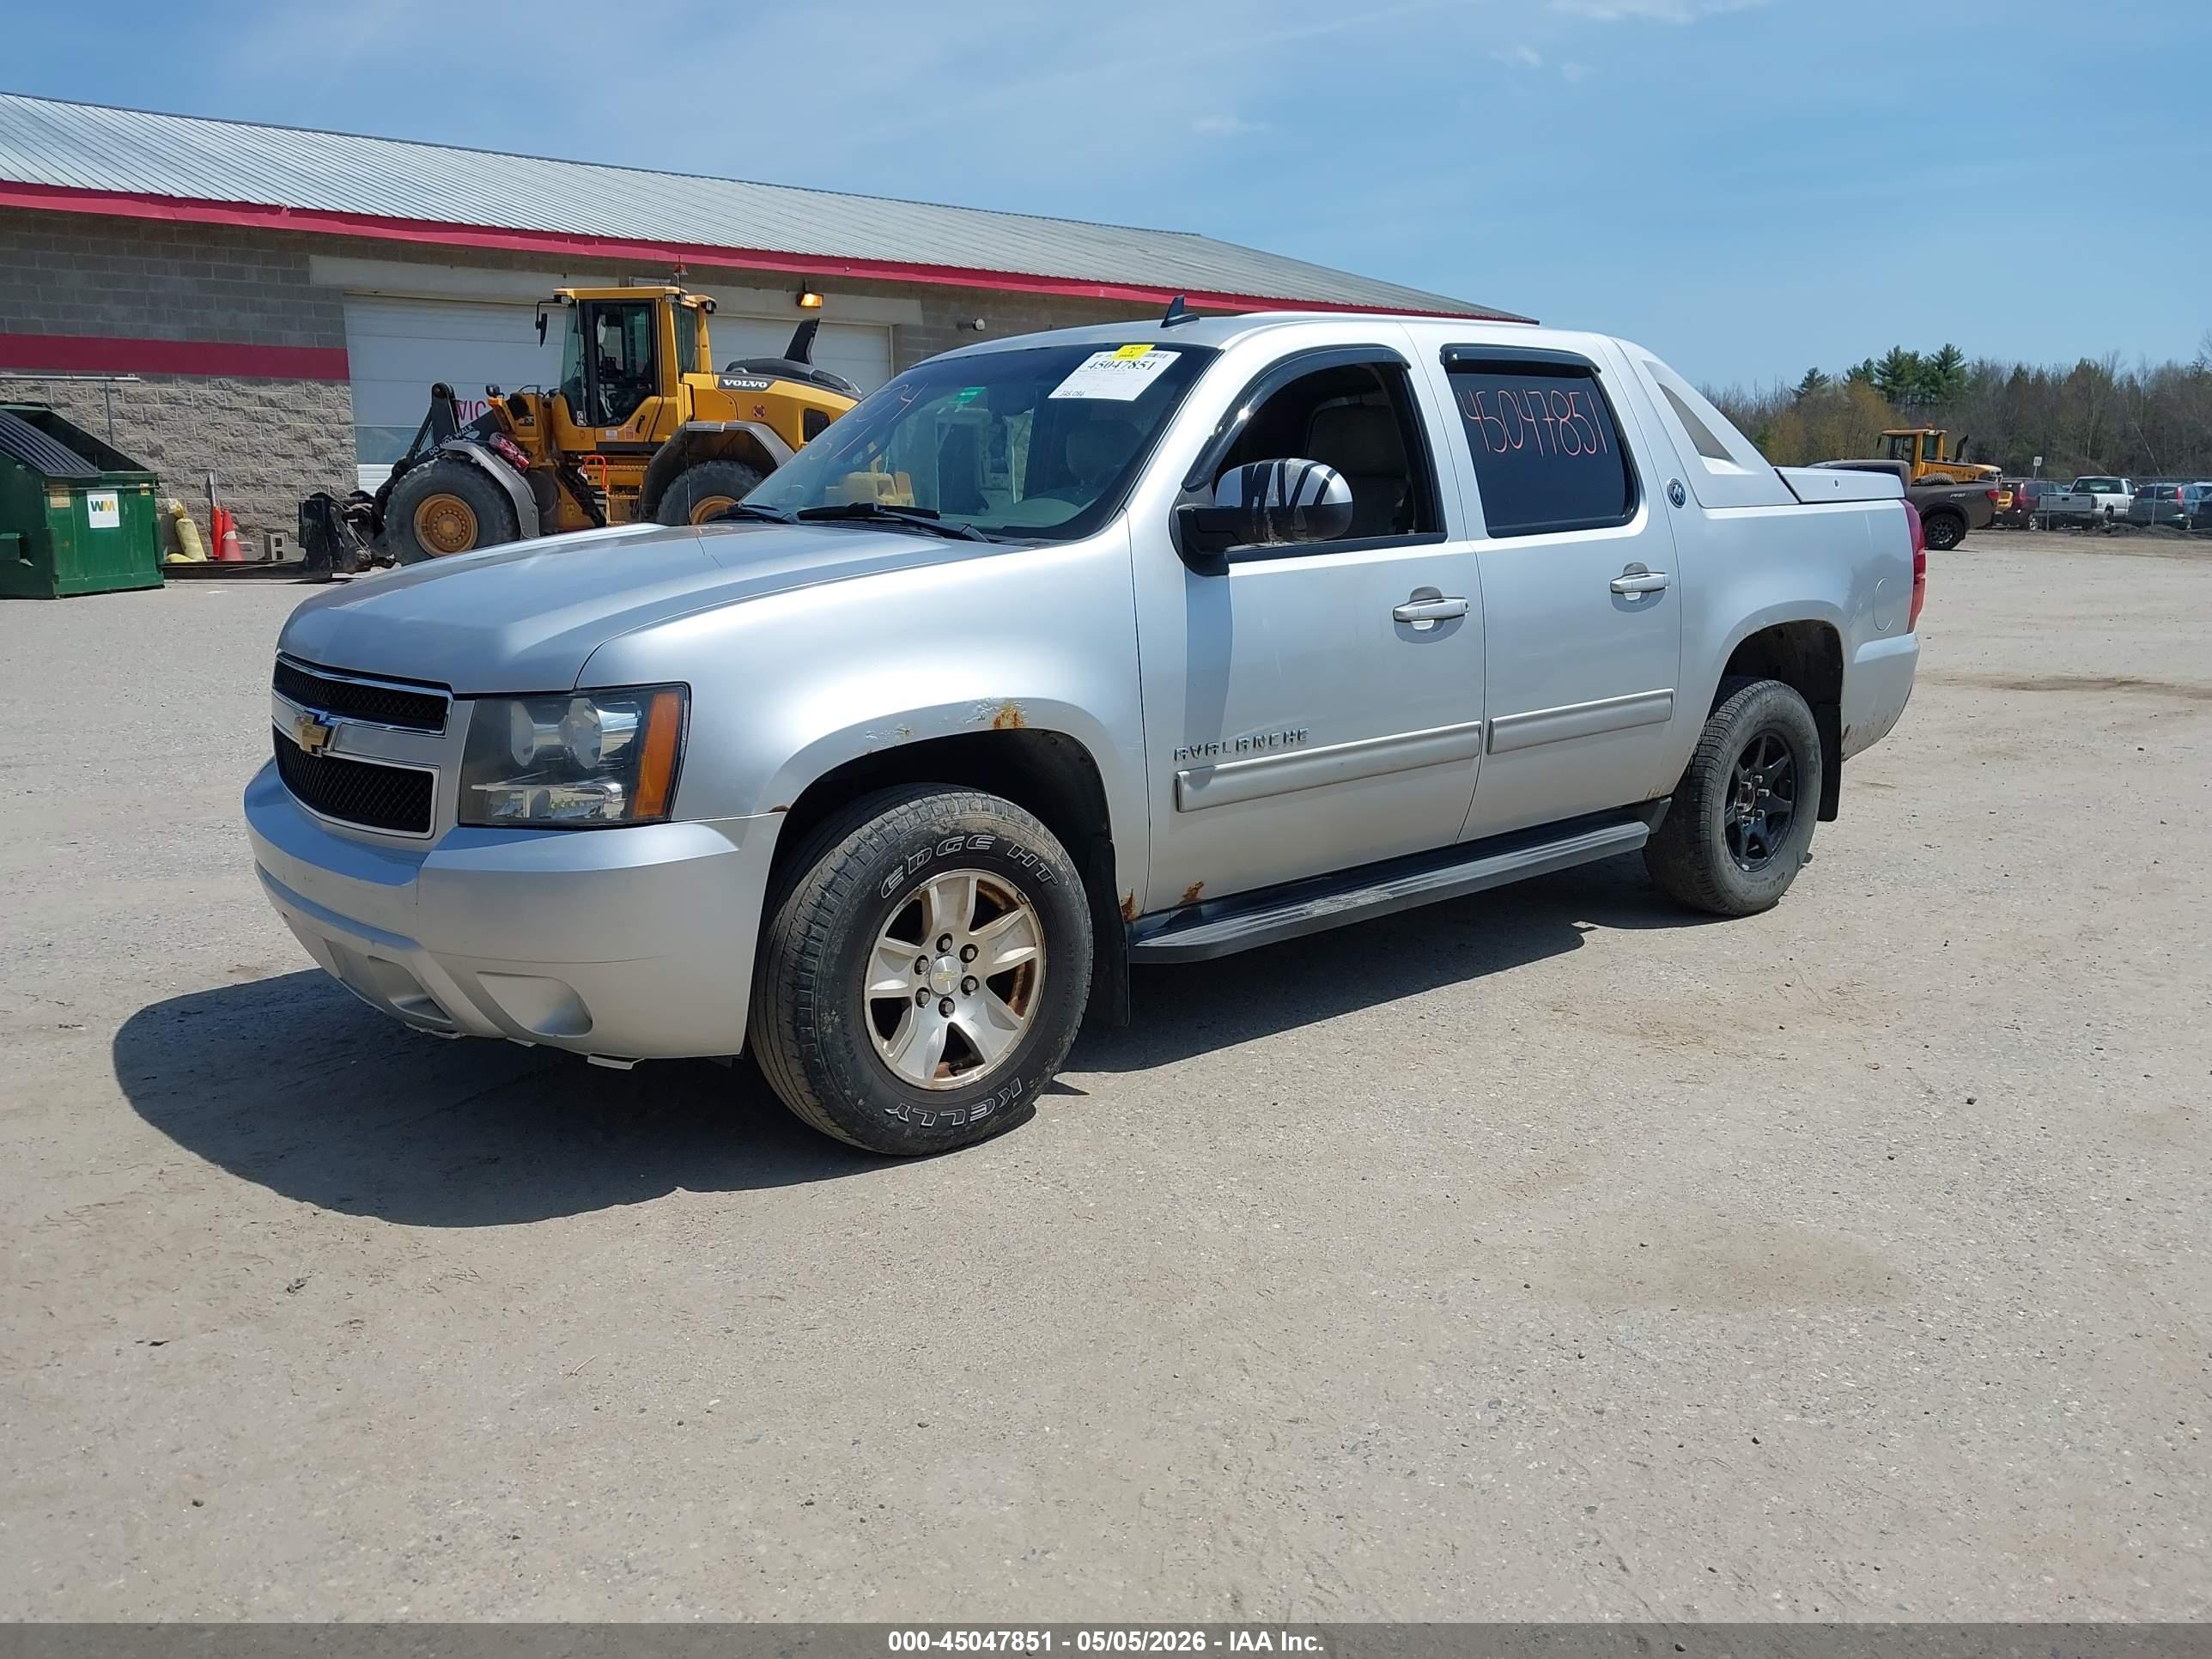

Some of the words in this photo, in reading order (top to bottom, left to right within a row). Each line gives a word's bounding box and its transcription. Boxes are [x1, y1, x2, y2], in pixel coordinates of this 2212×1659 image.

[1087, 360, 1157, 371] 45047851
[722, 379, 768, 388] VOLVO
[428, 445, 440, 455] DO
[439, 435, 454, 448] NOT
[453, 424, 474, 439] WALK
[1457, 389, 1608, 457] 45047851
[89, 500, 116, 512] WM
[1173, 727, 1310, 762] AVALANCHE
[880, 834, 997, 898] EDGE
[1006, 843, 1059, 886] HT
[884, 1077, 1023, 1127] KELLY
